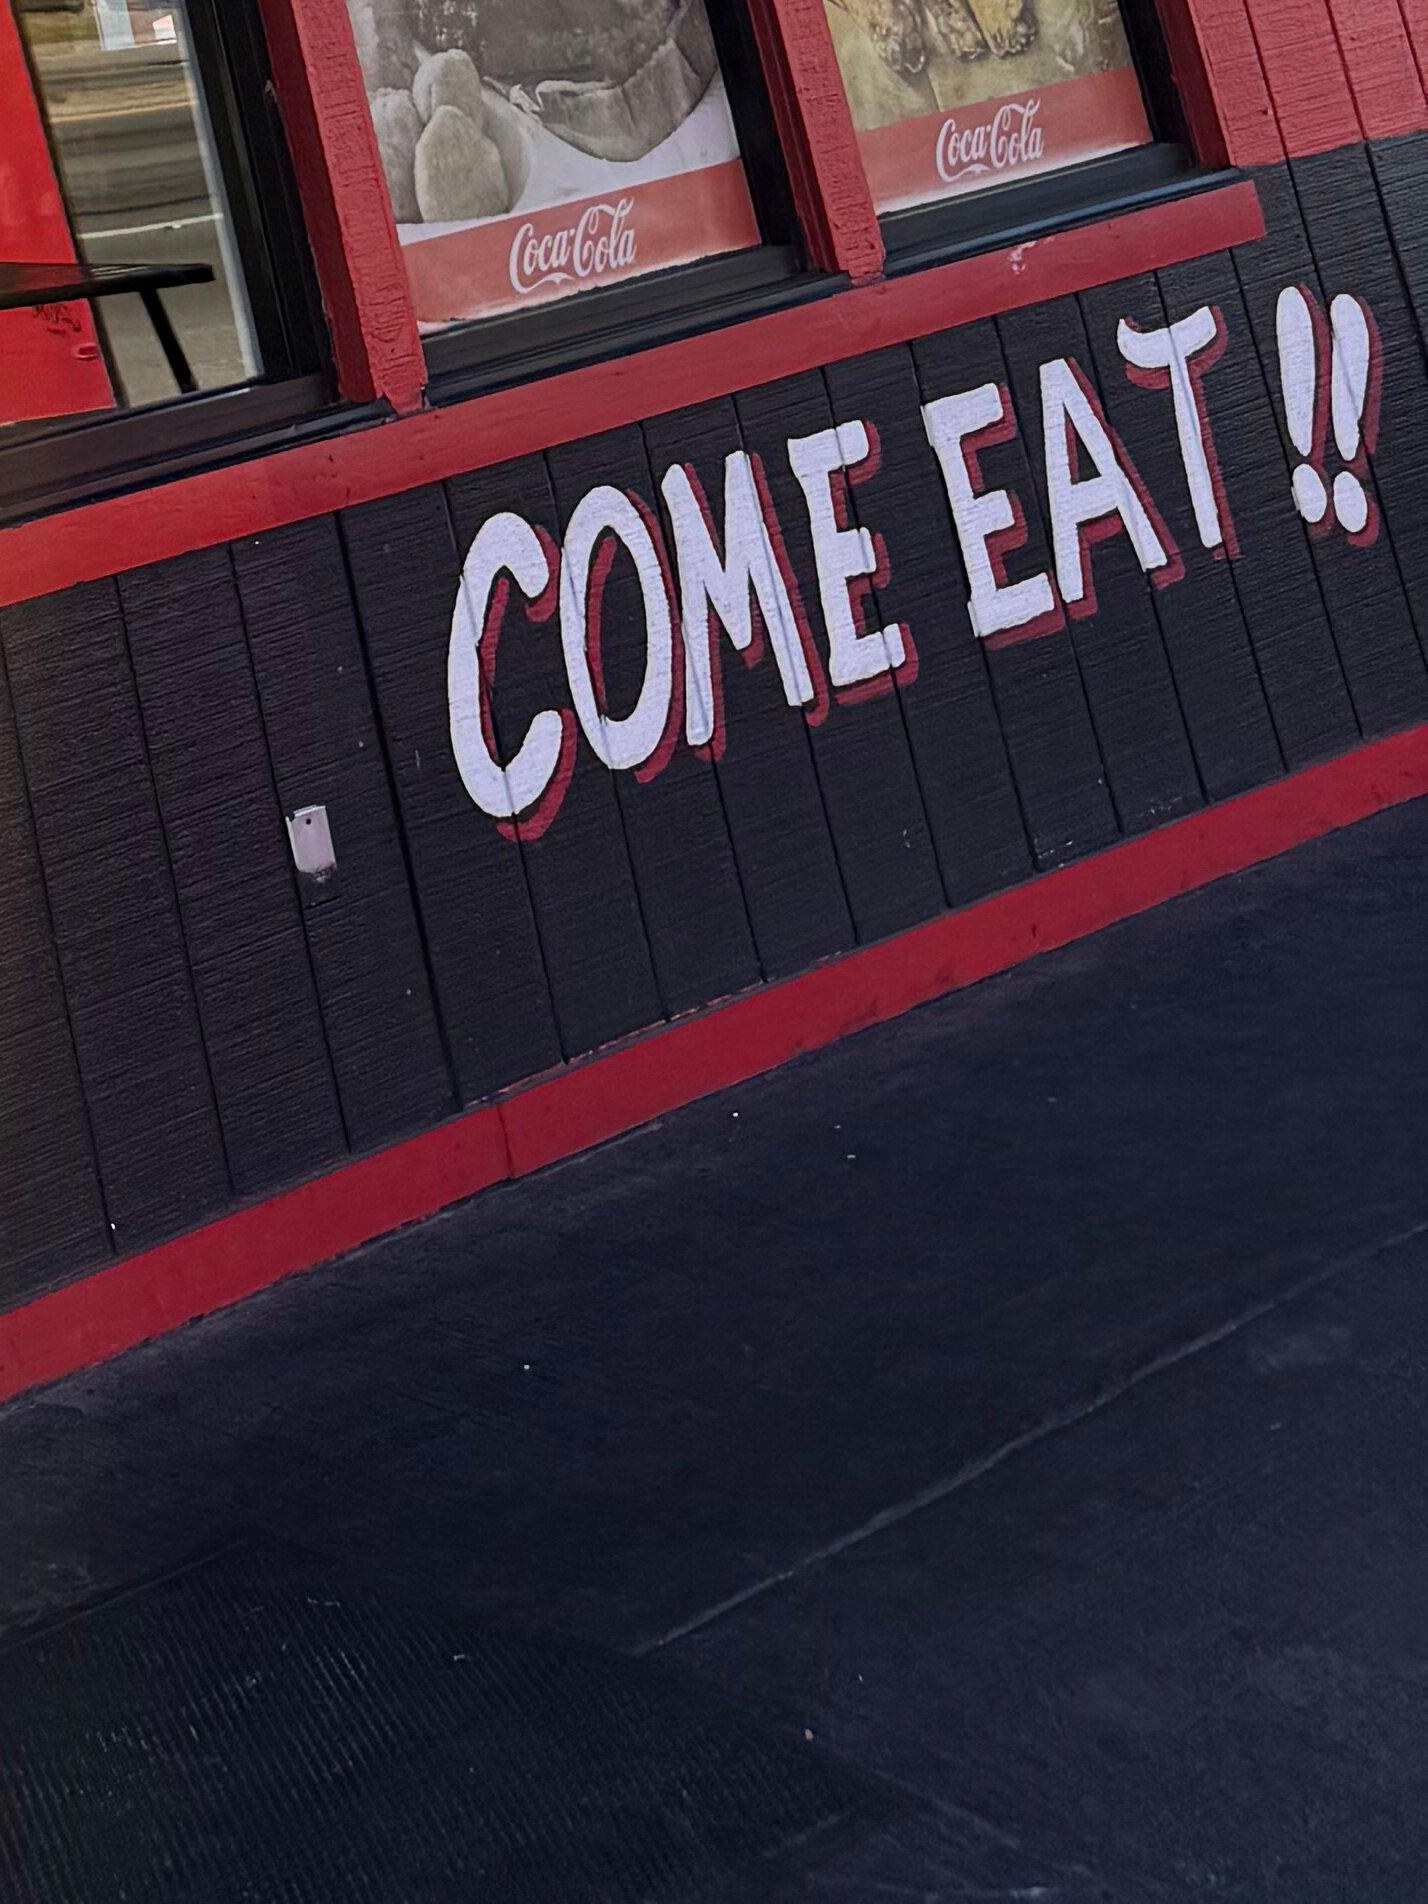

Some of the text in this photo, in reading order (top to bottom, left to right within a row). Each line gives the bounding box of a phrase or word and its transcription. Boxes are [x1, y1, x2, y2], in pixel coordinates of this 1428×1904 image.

[936, 100, 1044, 182] Coca-Cola
[509, 197, 636, 294] Coca-Cola
[447, 421, 912, 830] COME
[921, 306, 1224, 642] EAT
